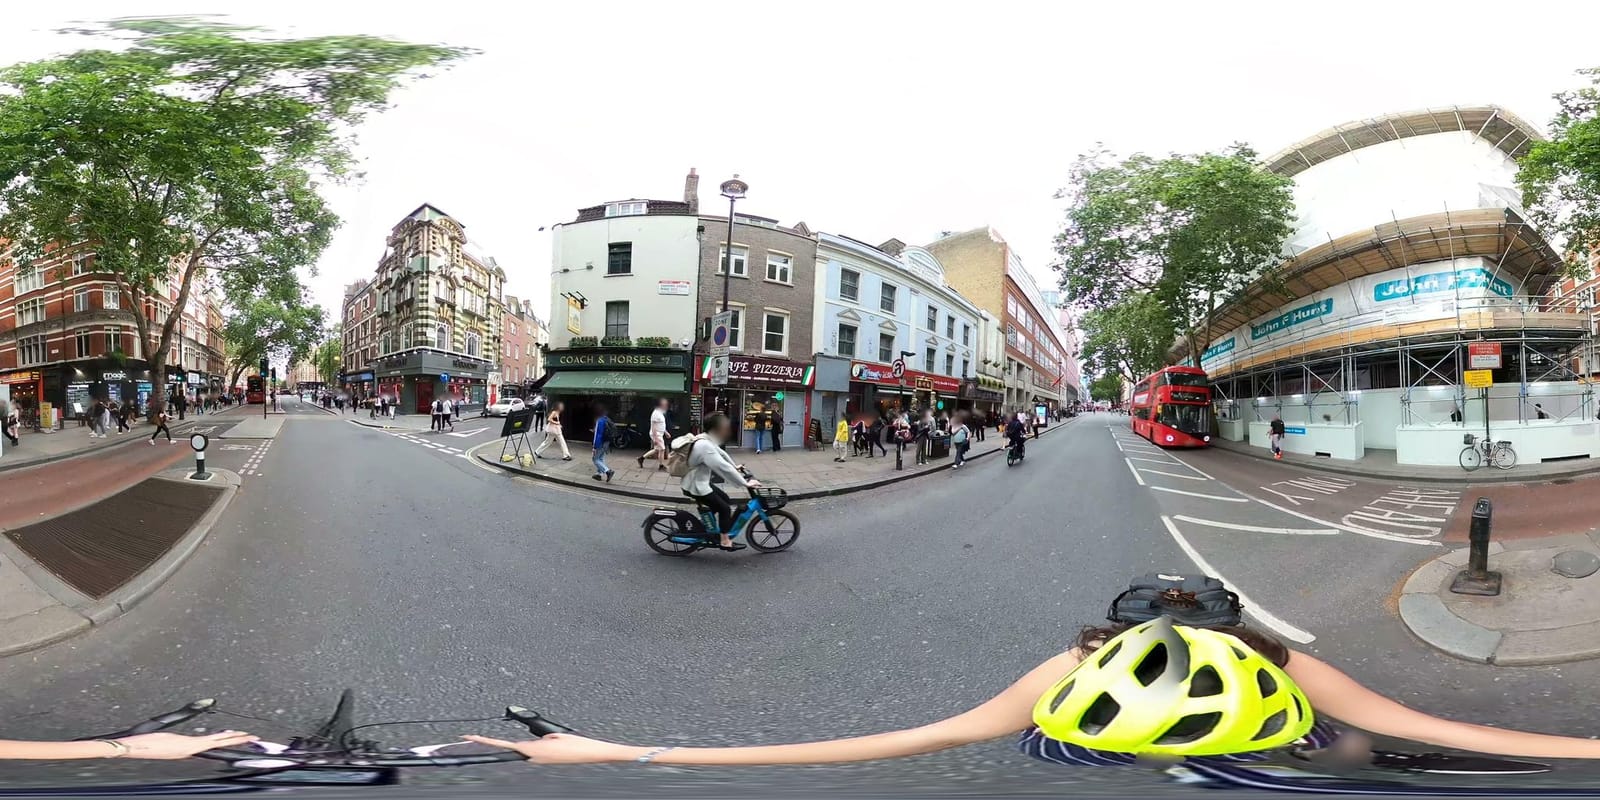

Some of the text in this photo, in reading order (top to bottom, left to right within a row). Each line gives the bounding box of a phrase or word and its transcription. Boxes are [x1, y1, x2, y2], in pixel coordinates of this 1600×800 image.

[1382, 277, 1439, 297] John
[1255, 303, 1328, 337] John F Hunt
[560, 355, 652, 365] COACH & HORSES
[728, 361, 803, 377] AFE PIZZERIA
[1259, 476, 1357, 506] ONLY
[1342, 485, 1462, 539] AHEAD
